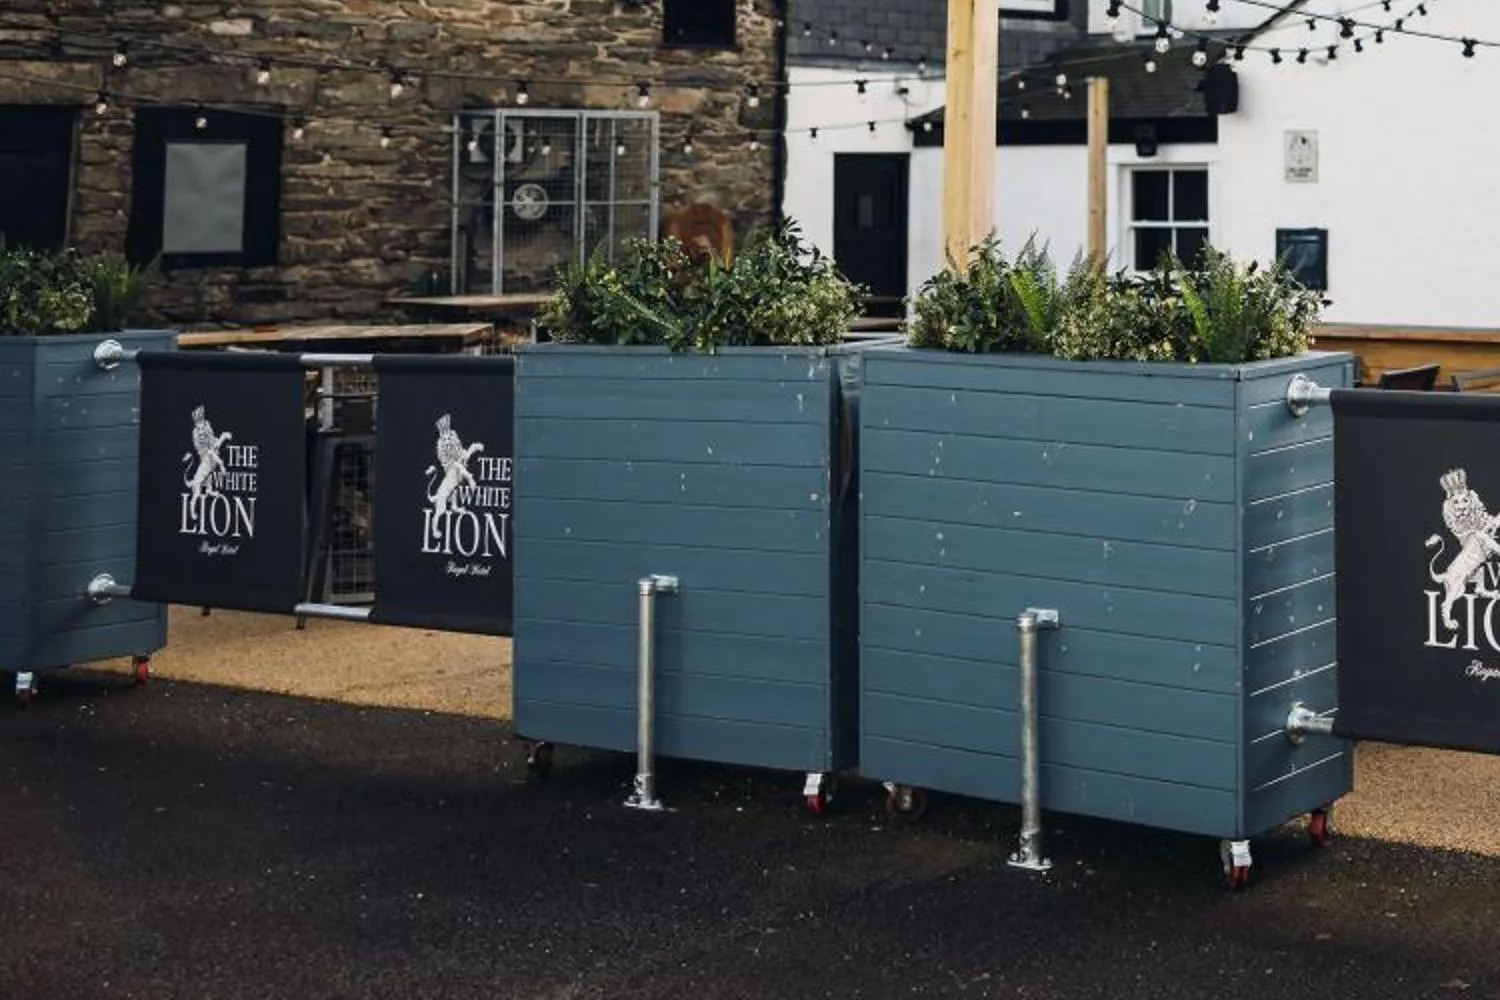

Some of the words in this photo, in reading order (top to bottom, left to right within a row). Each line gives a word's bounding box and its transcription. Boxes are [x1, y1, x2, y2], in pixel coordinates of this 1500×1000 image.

[226, 445, 258, 468] THE
[477, 457, 512, 481] THE
[211, 471, 257, 492] WHITE
[458, 485, 511, 508] WHITE
[179, 492, 257, 537] LION
[421, 508, 511, 559] LION
